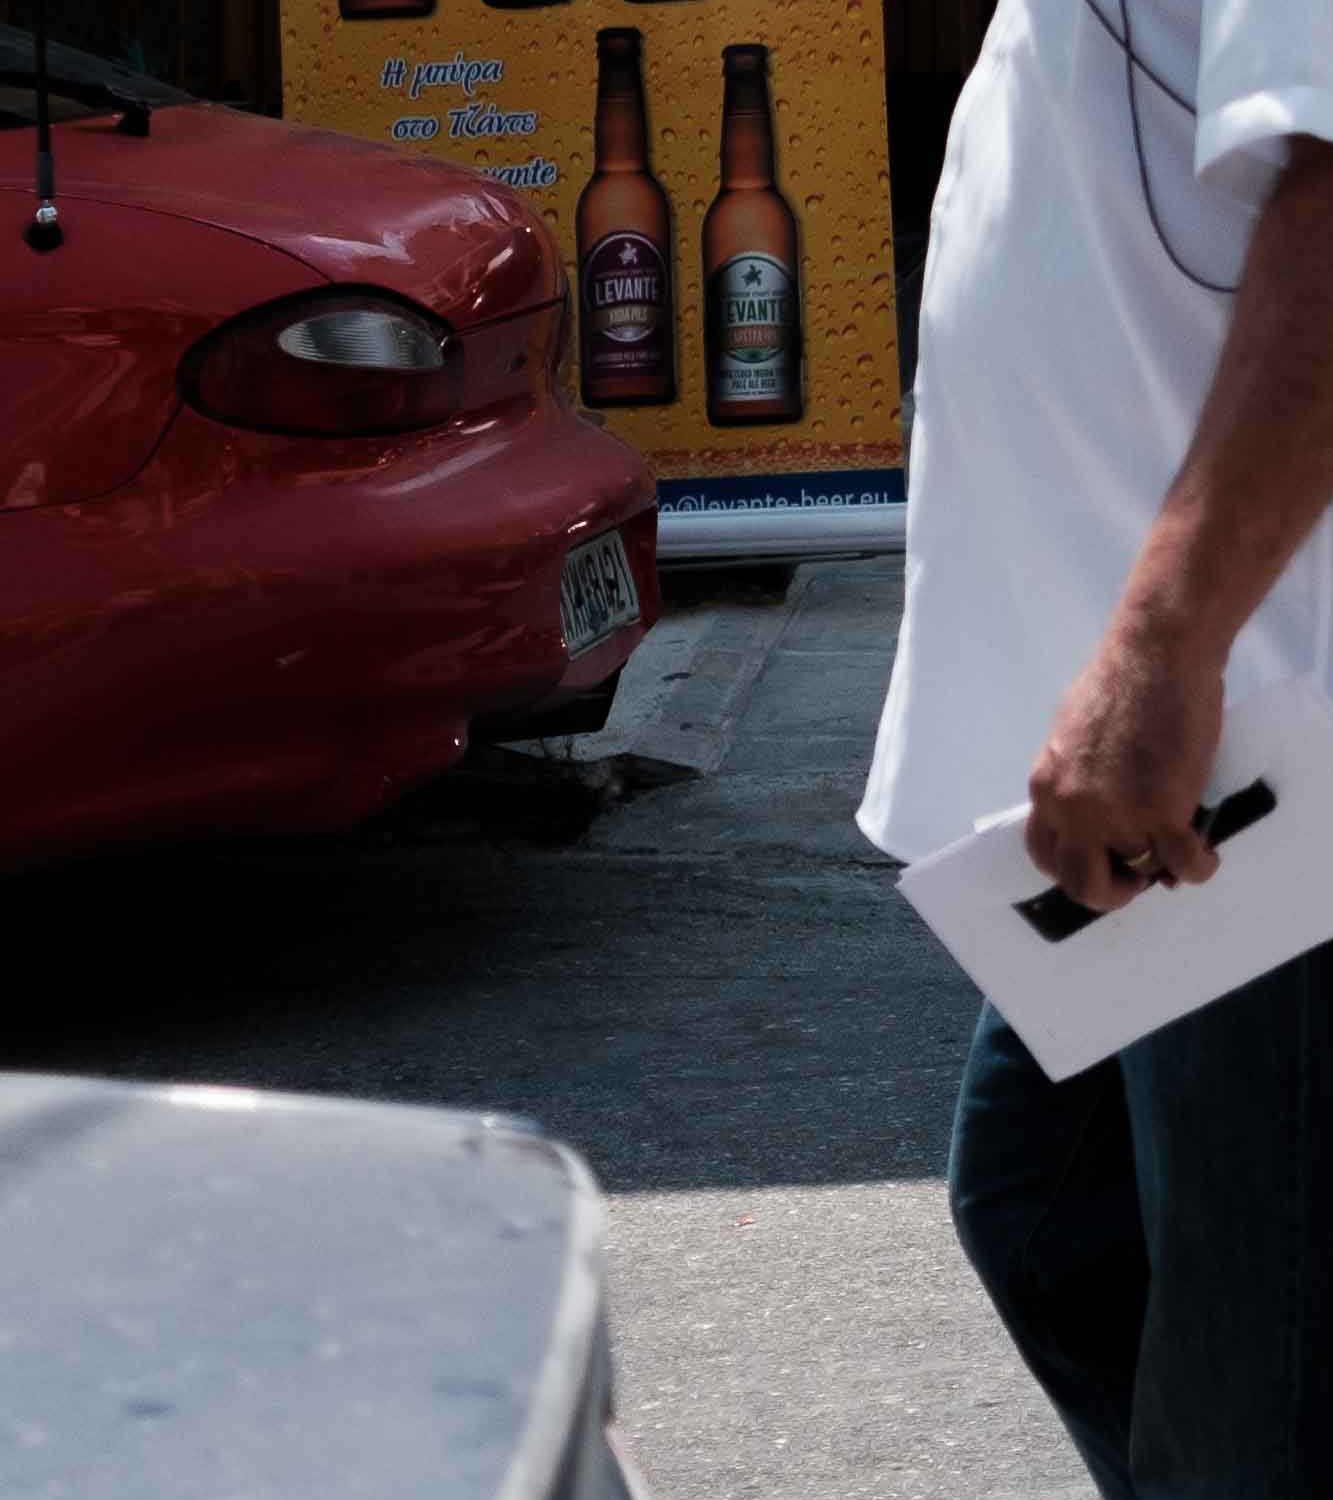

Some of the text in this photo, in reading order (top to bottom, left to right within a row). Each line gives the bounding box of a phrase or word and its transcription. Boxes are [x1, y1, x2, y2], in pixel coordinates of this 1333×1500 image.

[409, 51, 504, 99] μπύρα
[393, 104, 539, 141] στο Τζάντε
[594, 276, 660, 306] LEVANTE
